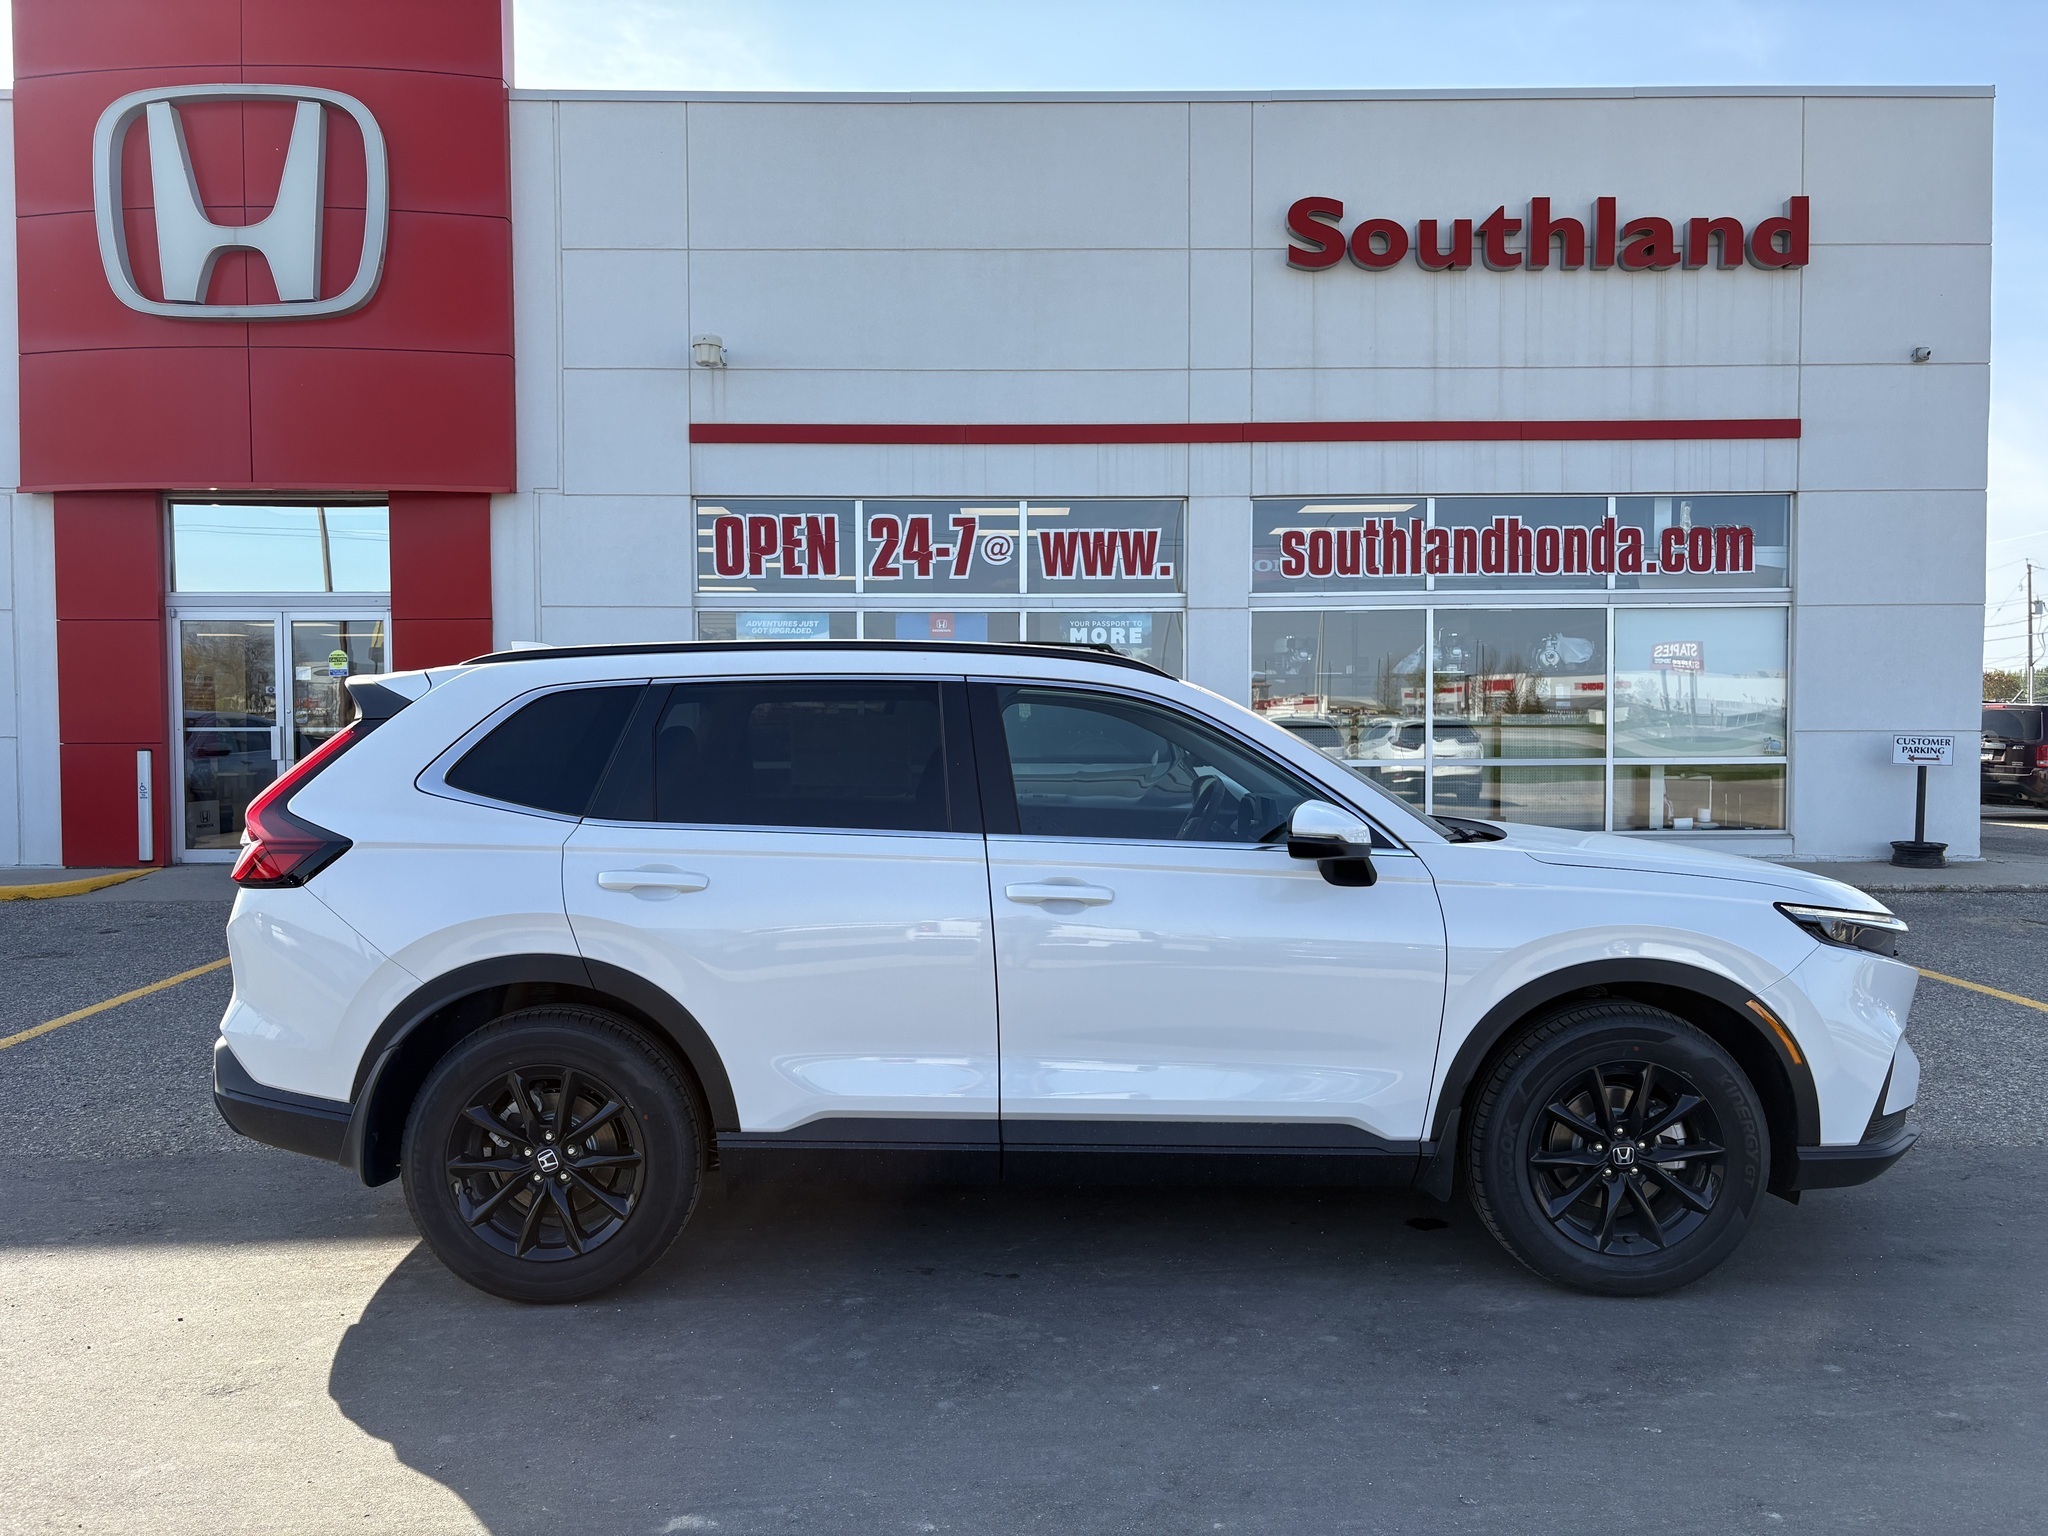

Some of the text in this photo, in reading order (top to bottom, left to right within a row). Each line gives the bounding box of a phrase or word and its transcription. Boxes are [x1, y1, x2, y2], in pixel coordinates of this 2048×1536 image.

[1286, 196, 1809, 271] Southland
[714, 514, 839, 579] OPEN
[868, 514, 978, 579] 24-7
[981, 533, 1013, 565] @
[1280, 516, 1755, 577] southlandhonda.com
[1069, 627, 1142, 644] MORE
[1896, 737, 1951, 746] CUSTOMER
[1902, 746, 1945, 755] PARKING
